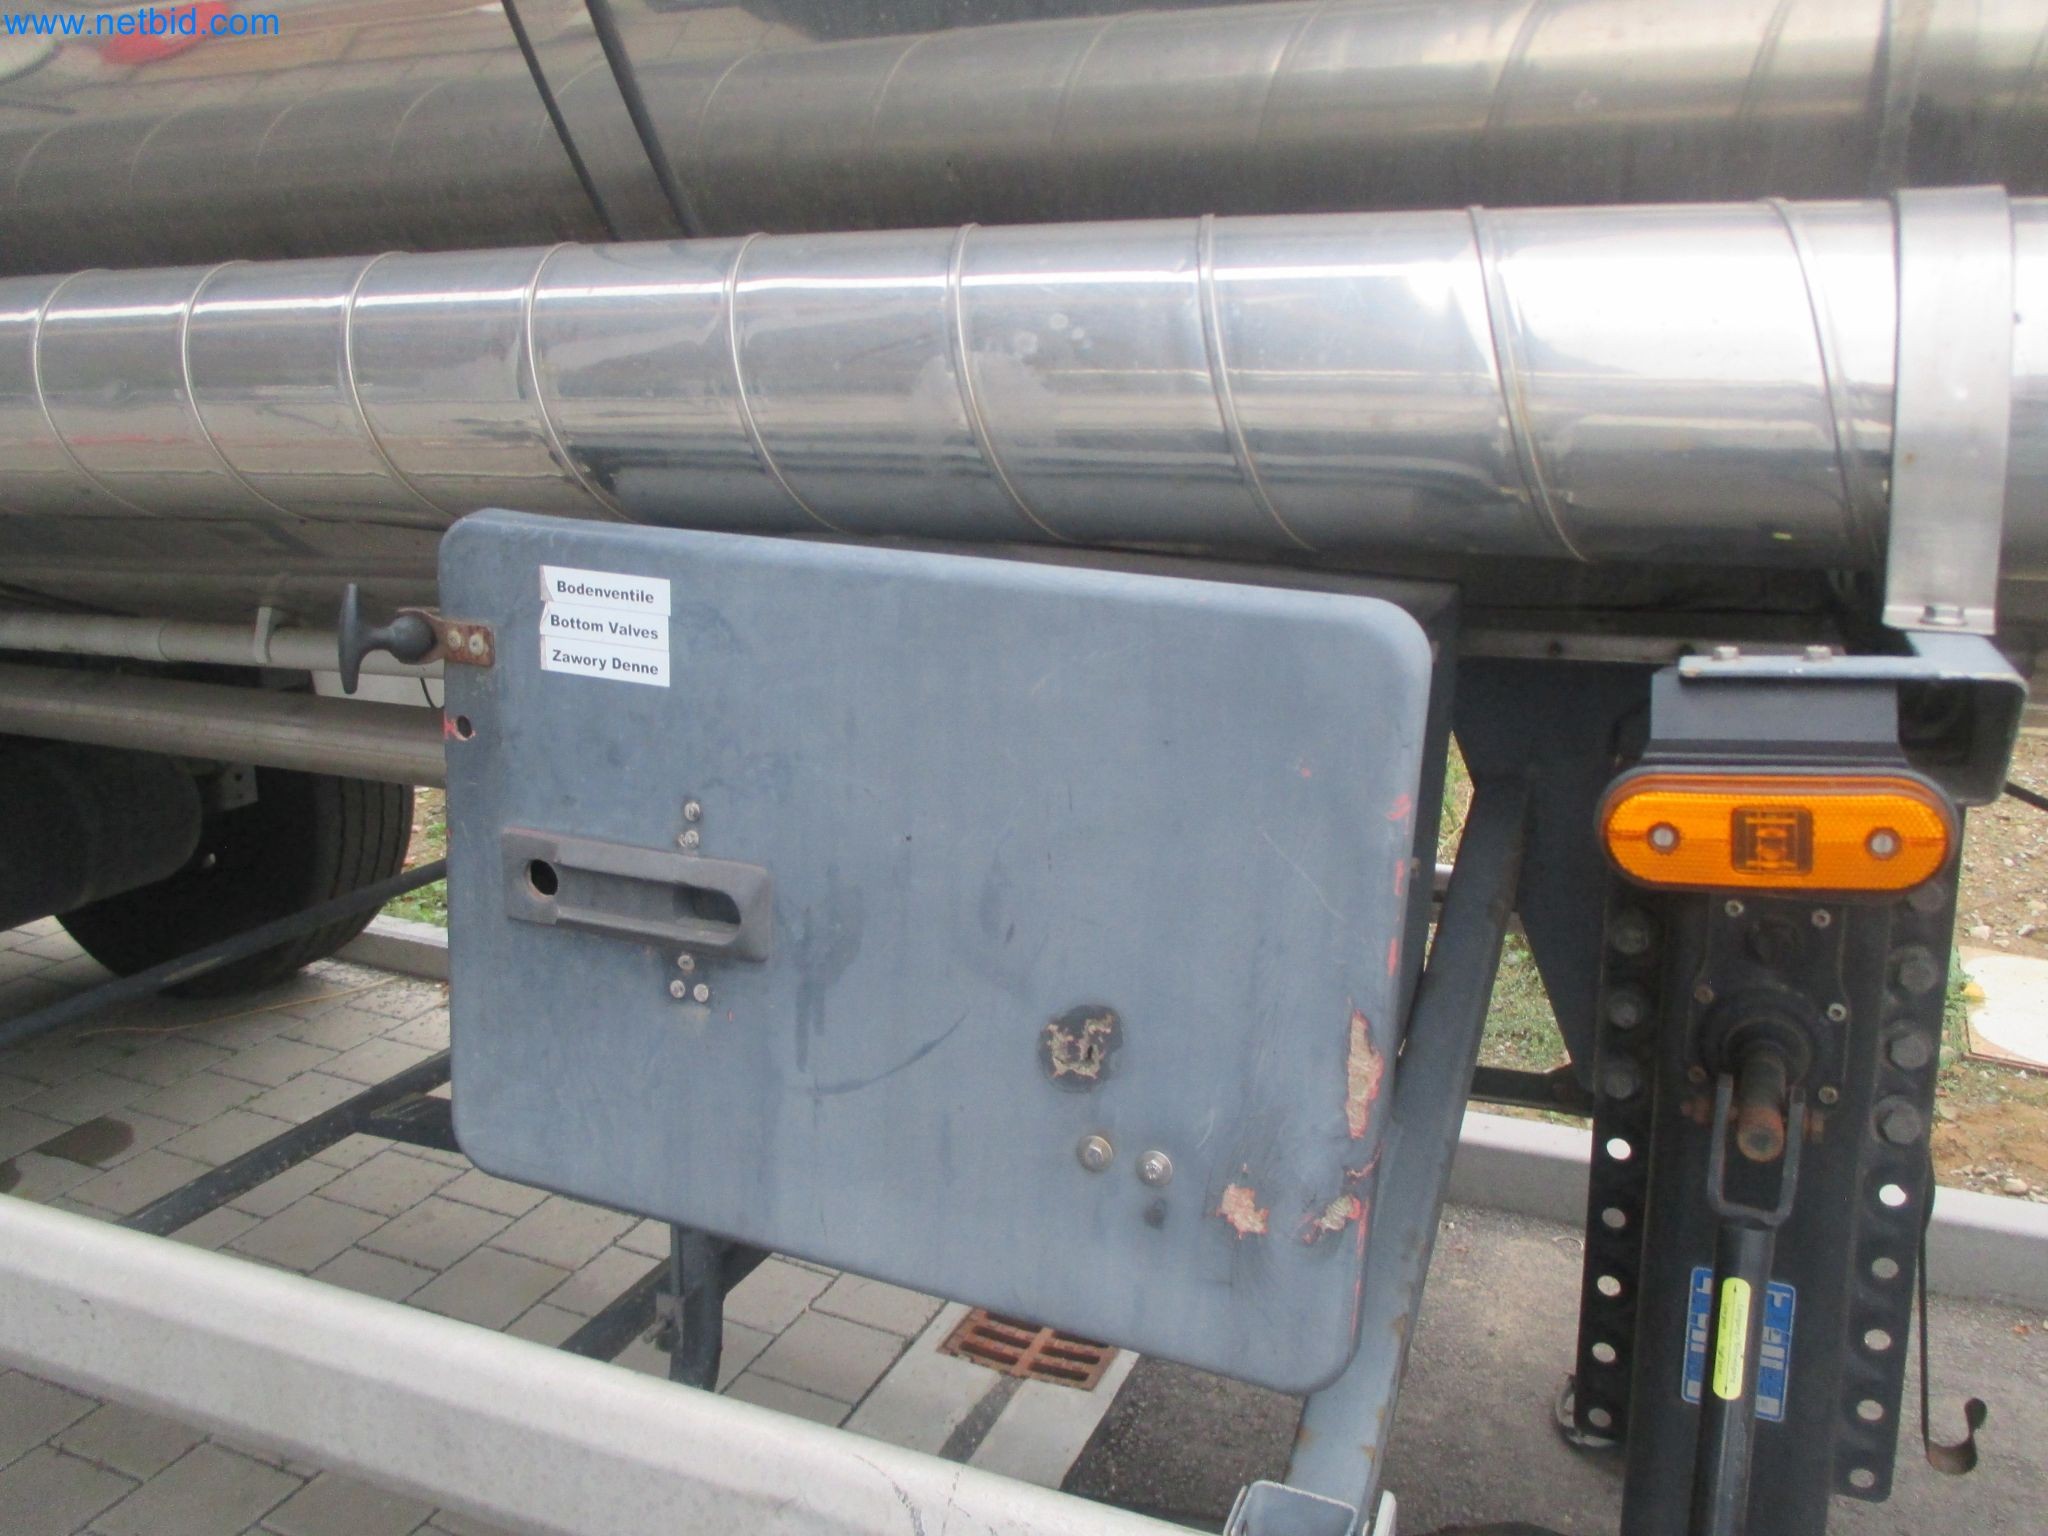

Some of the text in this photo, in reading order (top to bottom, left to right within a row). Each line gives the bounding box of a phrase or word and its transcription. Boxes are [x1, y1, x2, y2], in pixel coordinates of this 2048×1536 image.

[557, 580, 654, 603] Bodenventile
[550, 614, 659, 640] Bottom Valves
[552, 649, 659, 675] Zawory Denne
